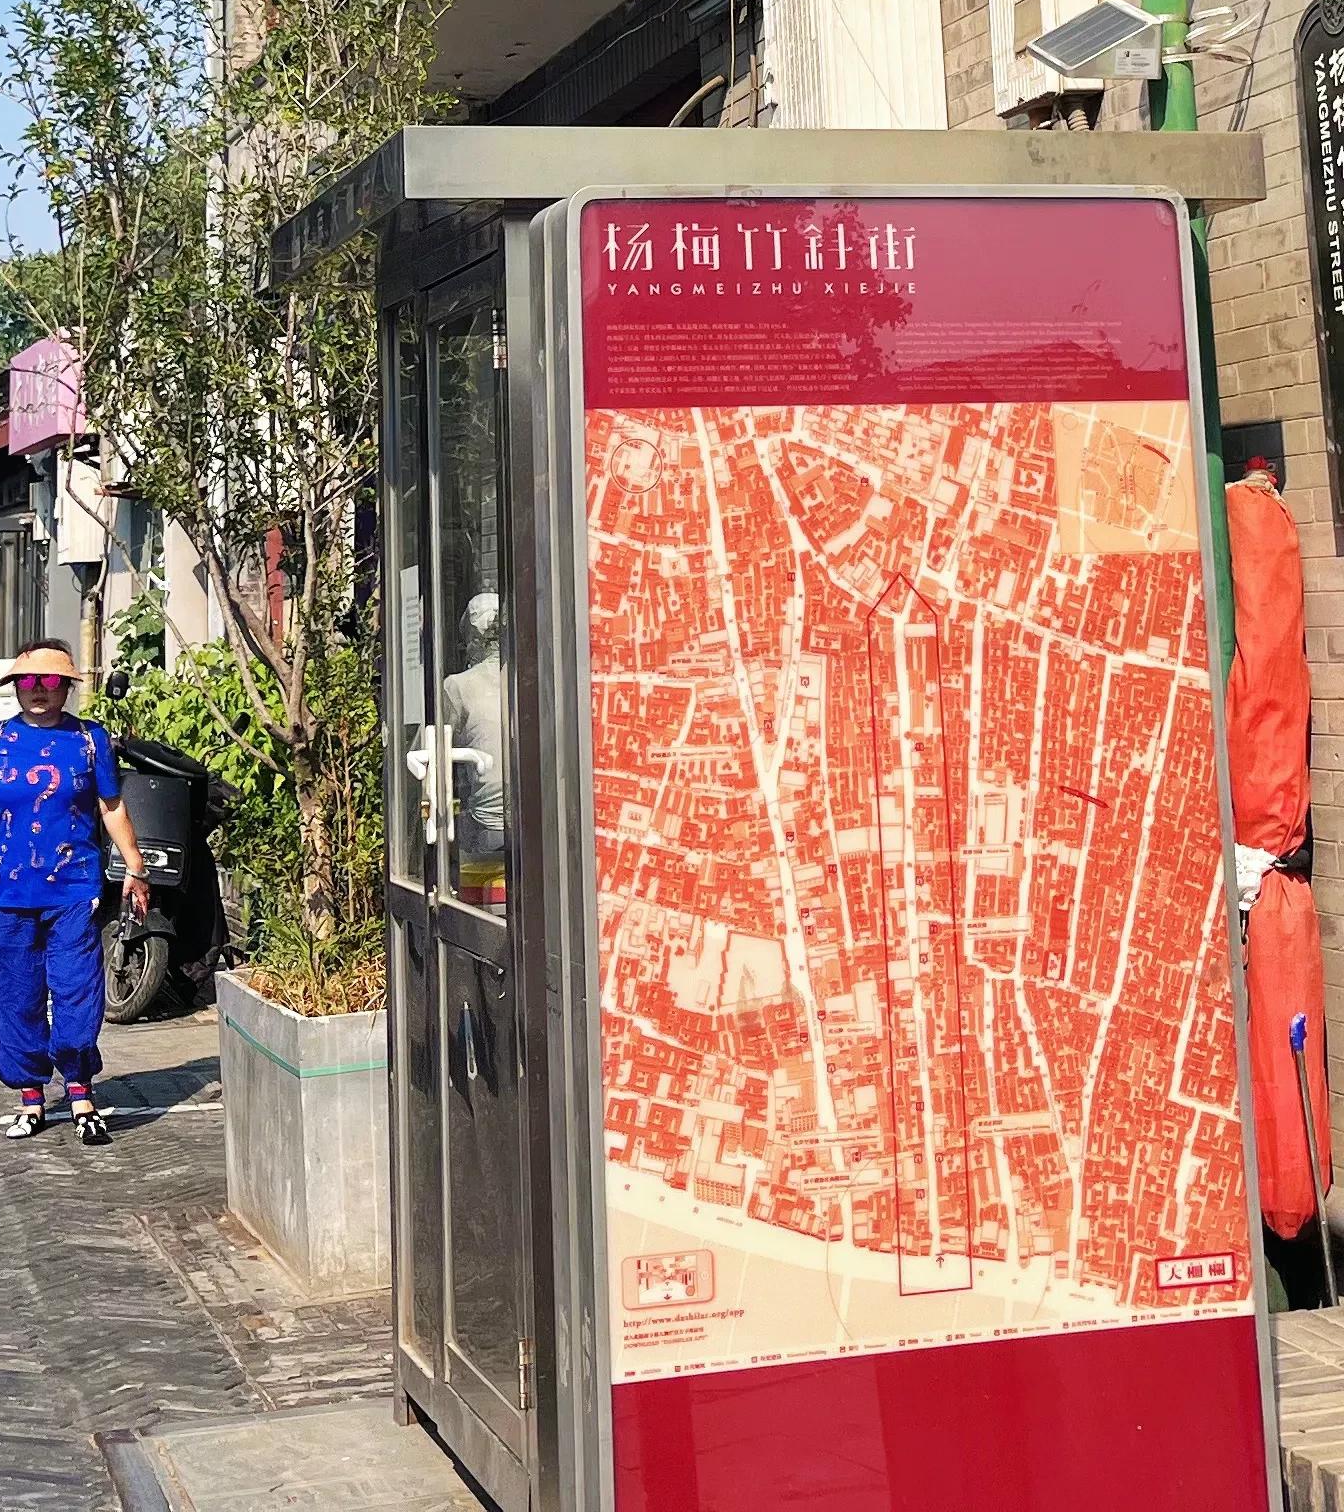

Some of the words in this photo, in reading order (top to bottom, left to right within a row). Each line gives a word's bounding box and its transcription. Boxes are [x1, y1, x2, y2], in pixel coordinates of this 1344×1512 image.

[1313, 53, 1337, 212] YANGMEIZHU
[603, 223, 918, 272] 杨梅竹斜街
[608, 282, 803, 296] YANGMEIZHU
[824, 282, 918, 296] XIEJIE
